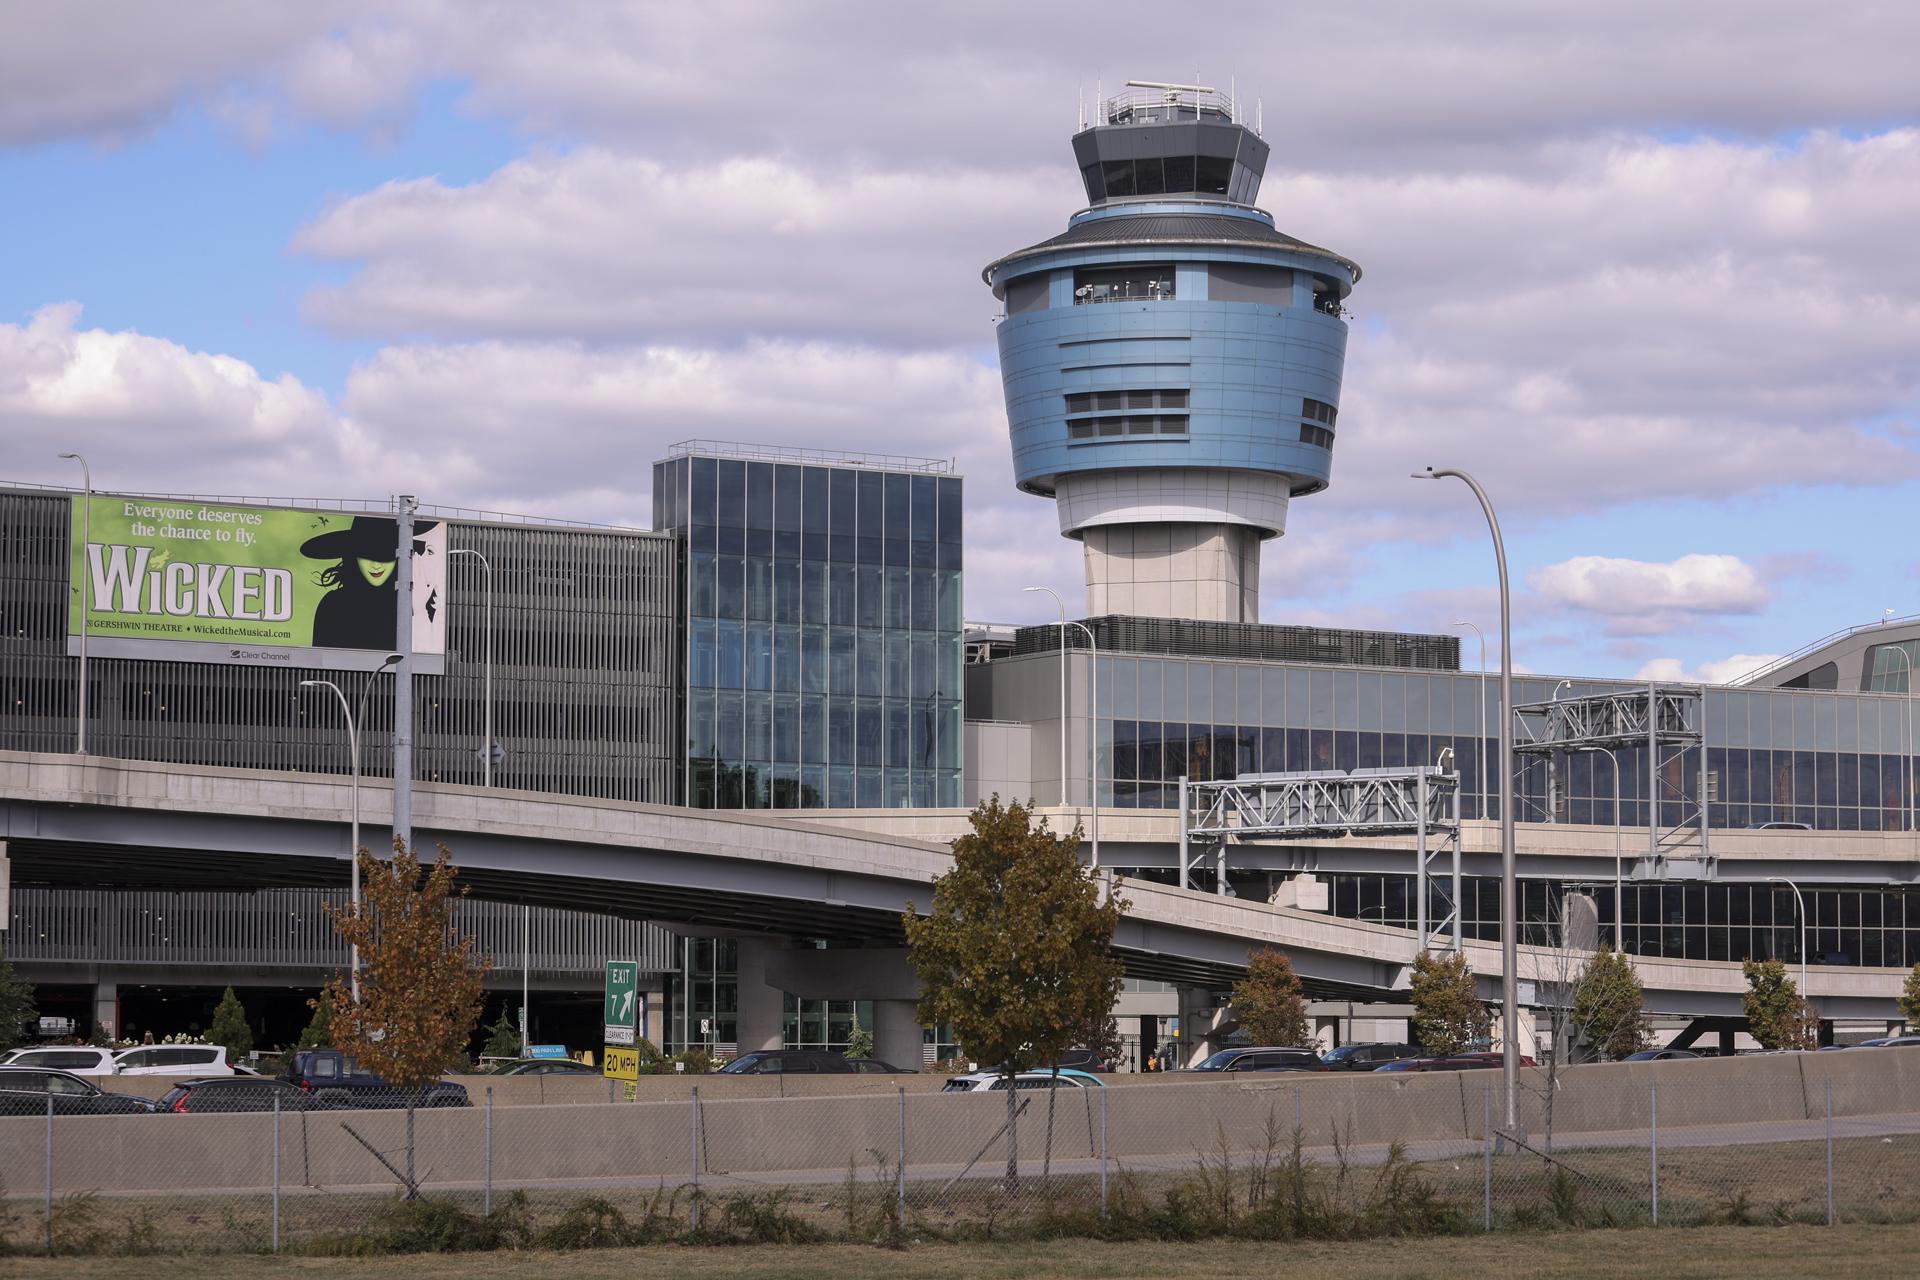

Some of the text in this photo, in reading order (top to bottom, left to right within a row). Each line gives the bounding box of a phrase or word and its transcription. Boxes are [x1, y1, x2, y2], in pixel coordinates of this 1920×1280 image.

[124, 502, 262, 525] Everyone deserves
[132, 522, 257, 547] the chance to fly.
[94, 620, 291, 639] GERSHWIN THEATRE WickedtheMusical.com
[241, 651, 290, 661] Clear Channel
[612, 968, 630, 984] EXIT
[611, 994, 618, 1017] 7
[605, 1030, 625, 1040] CLEARANCE
[606, 1053, 636, 1072] 20 MPH
